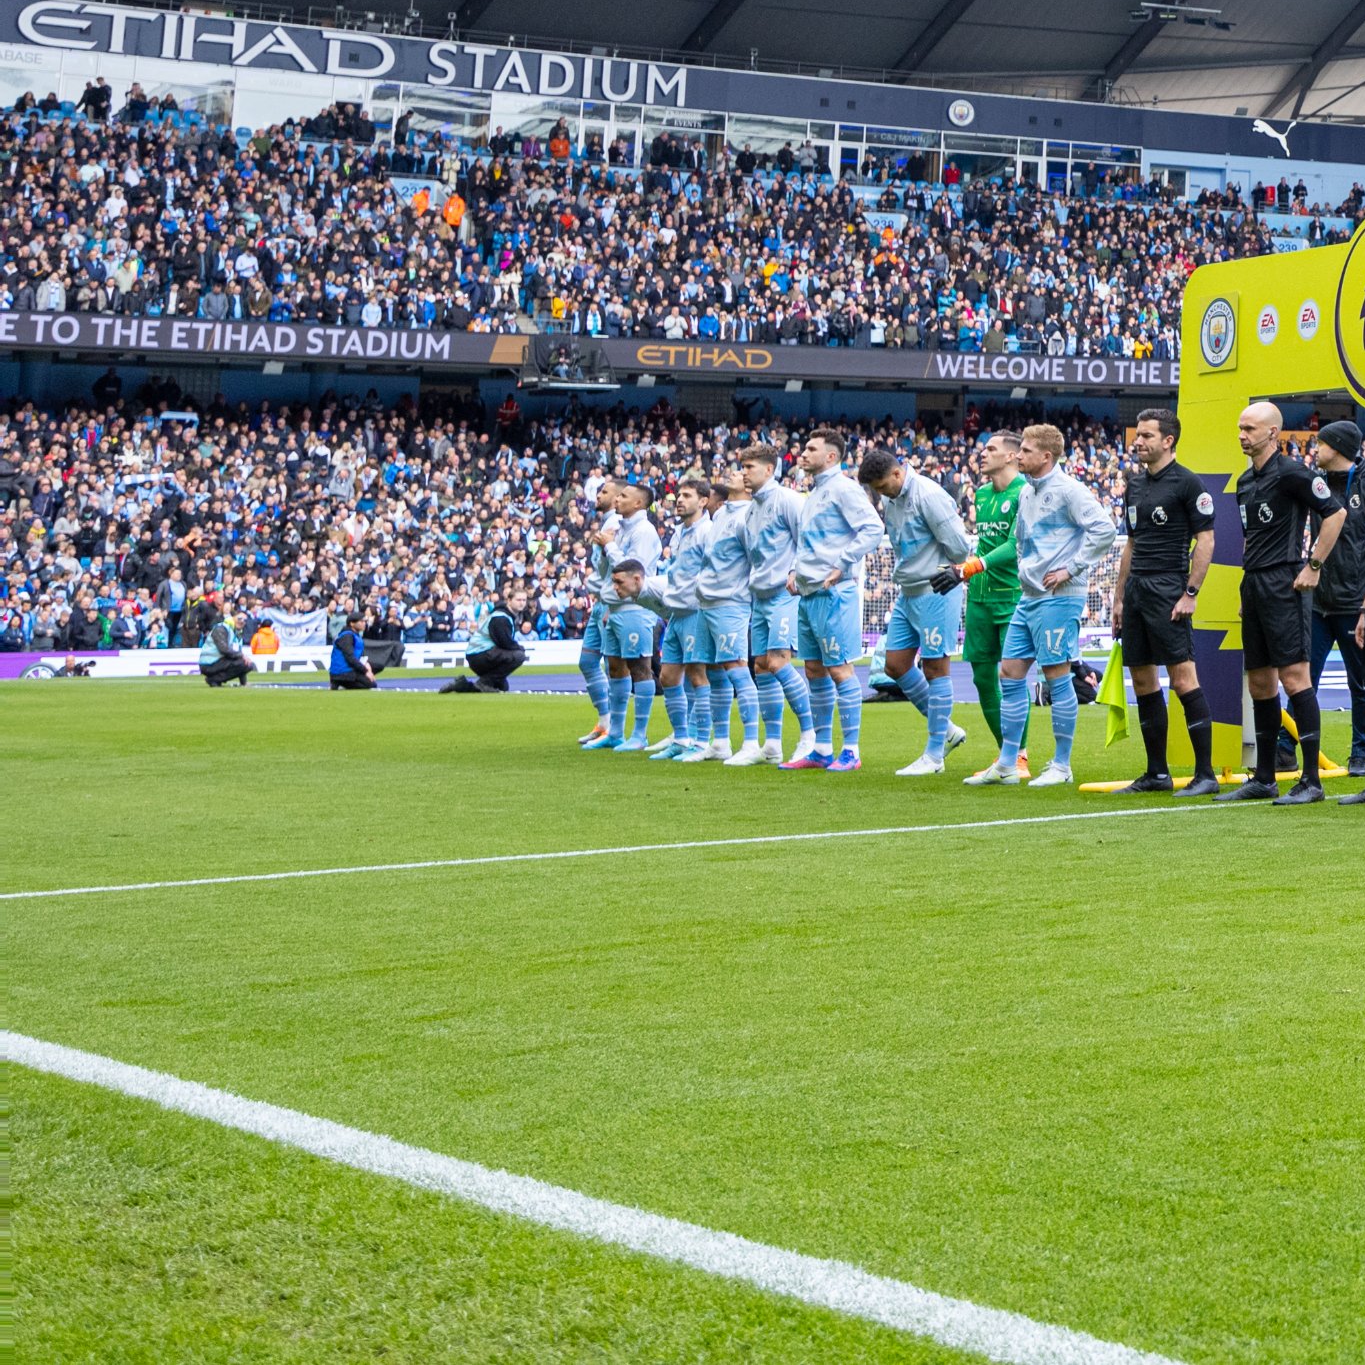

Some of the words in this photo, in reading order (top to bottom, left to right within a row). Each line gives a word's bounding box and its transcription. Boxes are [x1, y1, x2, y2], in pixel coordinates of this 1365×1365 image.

[17, 0, 396, 78] ETIHAD
[426, 41, 687, 108] STADIUM
[401, 185, 424, 197] 23
[1279, 244, 1297, 253] 239
[1204, 303, 1233, 326] MANCHESTER
[1261, 313, 1275, 327] EA
[1301, 308, 1316, 322] EA
[1260, 325, 1276, 335] SPORTS
[1300, 320, 1317, 330] SPORTS
[30, 314, 80, 345] TO
[91, 317, 160, 347] THE
[171, 321, 297, 354] ETIHAD
[305, 328, 451, 361] STADIUM
[637, 344, 773, 370] ETIHAD
[1211, 354, 1223, 362] CITY
[936, 354, 1065, 382] WELCOME
[1073, 359, 1107, 383] TO
[1114, 360, 1162, 385] THE
[974, 522, 1008, 531] TIHAD
[779, 618, 789, 635] 5
[628, 633, 639, 648] 9
[718, 632, 738, 651] 27
[822, 636, 840, 654] 14
[923, 627, 942, 646] 16
[1044, 628, 1066, 652] 17
